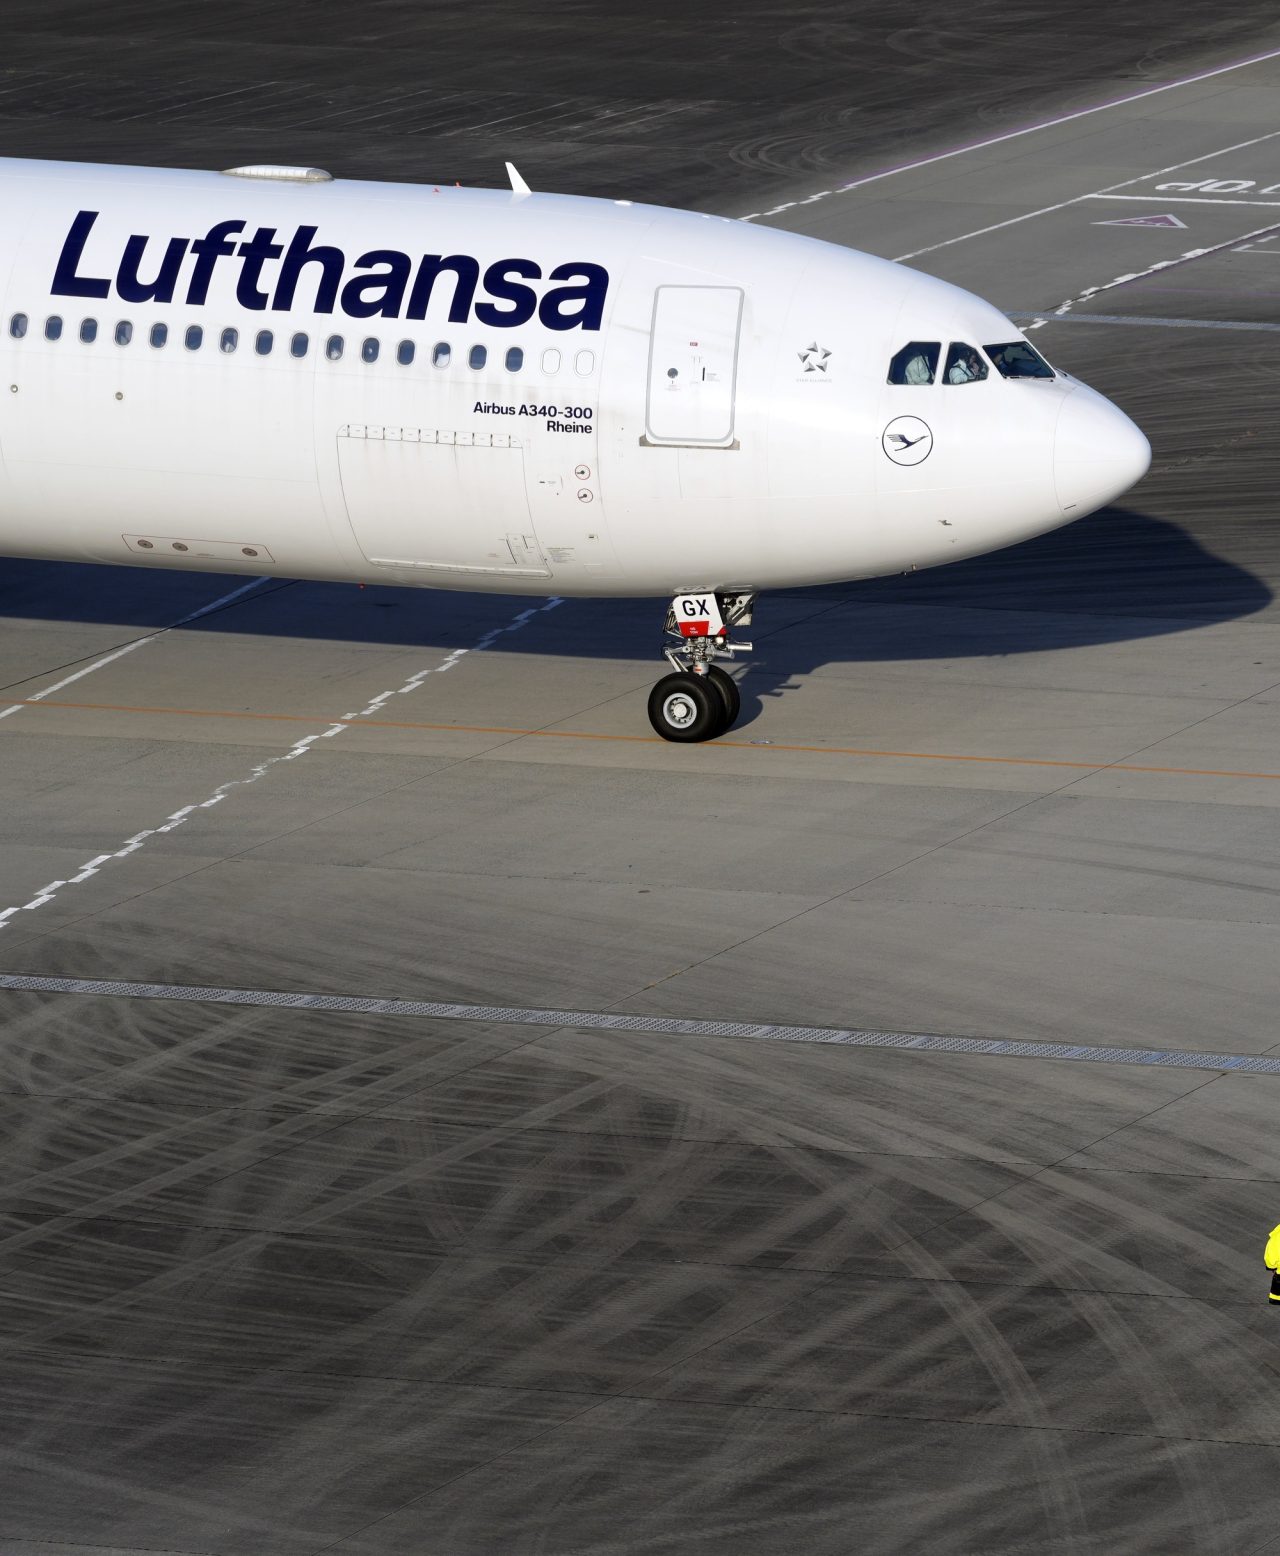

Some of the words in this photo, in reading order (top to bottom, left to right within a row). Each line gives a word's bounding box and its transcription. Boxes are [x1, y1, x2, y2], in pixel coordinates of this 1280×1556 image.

[50, 210, 610, 332] Lufthansa
[473, 401, 516, 416] Airbus
[518, 404, 593, 420] A340-300
[546, 420, 593, 434] Rheine
[682, 599, 711, 617] GX
